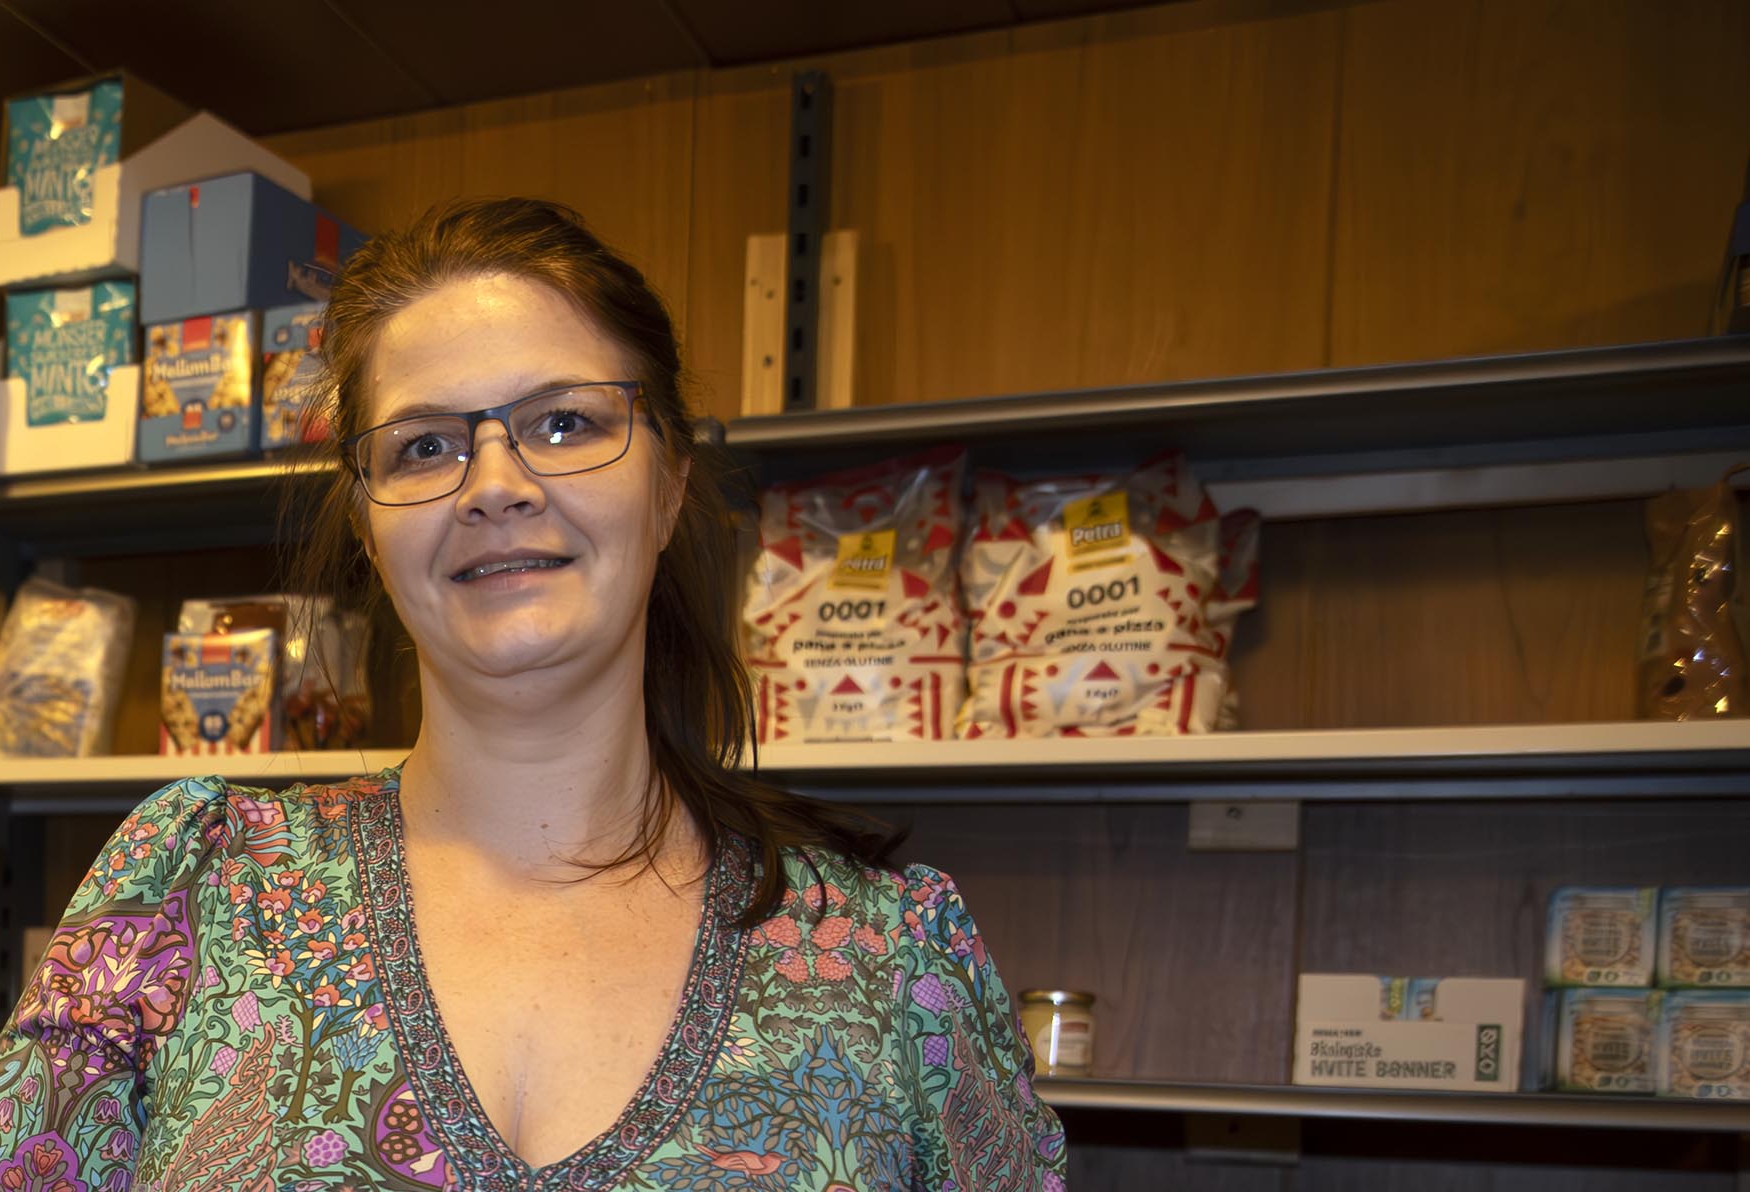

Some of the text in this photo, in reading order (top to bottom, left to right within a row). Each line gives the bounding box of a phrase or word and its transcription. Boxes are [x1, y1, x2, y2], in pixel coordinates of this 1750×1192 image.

[1066, 576, 1141, 609] 0001
[818, 601, 886, 622] 0001
[1311, 1059, 1367, 1078] HVITE
